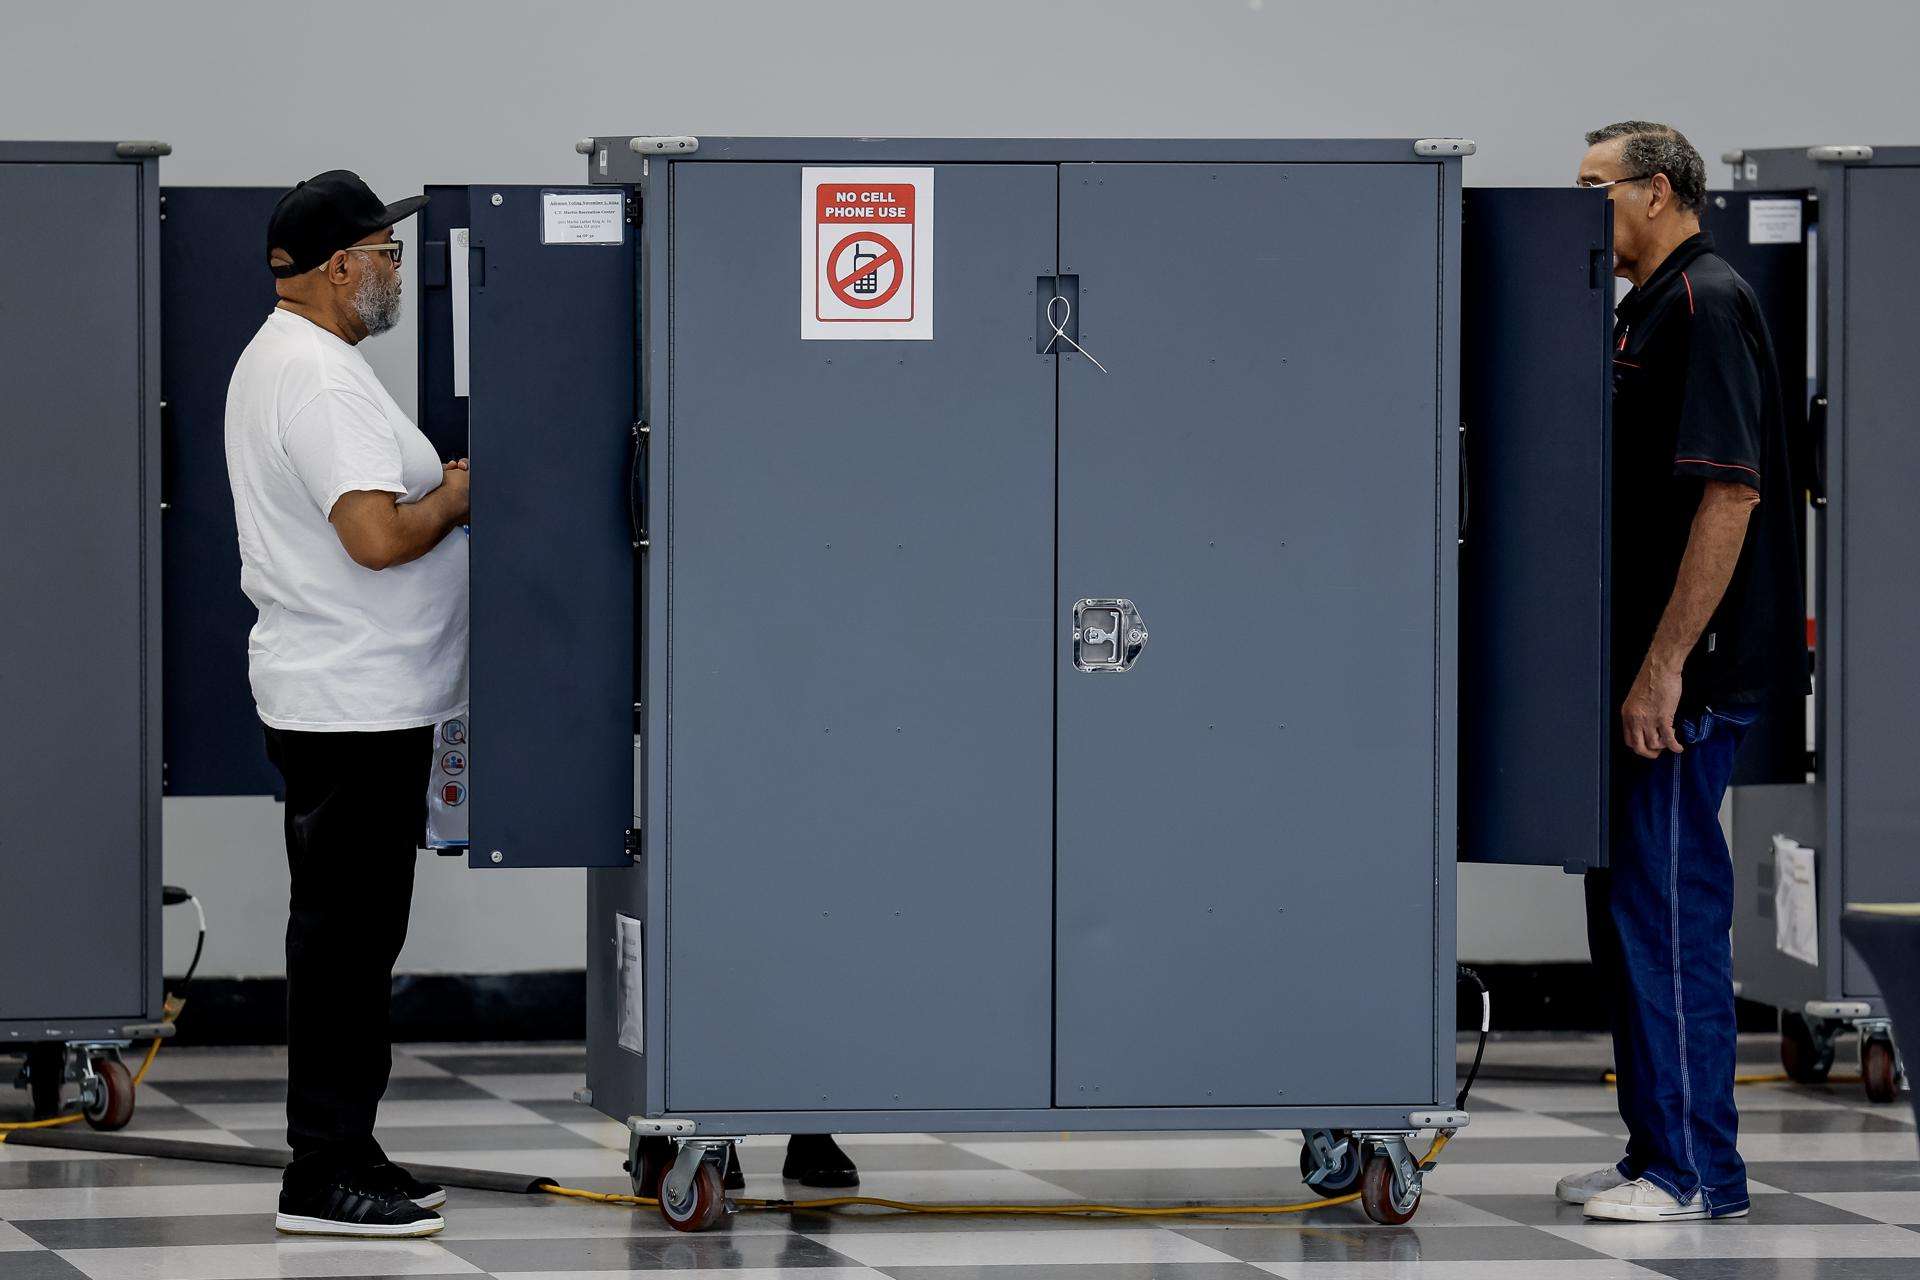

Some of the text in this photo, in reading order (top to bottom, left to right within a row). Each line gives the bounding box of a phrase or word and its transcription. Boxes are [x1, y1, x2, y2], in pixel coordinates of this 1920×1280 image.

[836, 192, 896, 203] NO CELL
[825, 207, 906, 218] PHONE USE
